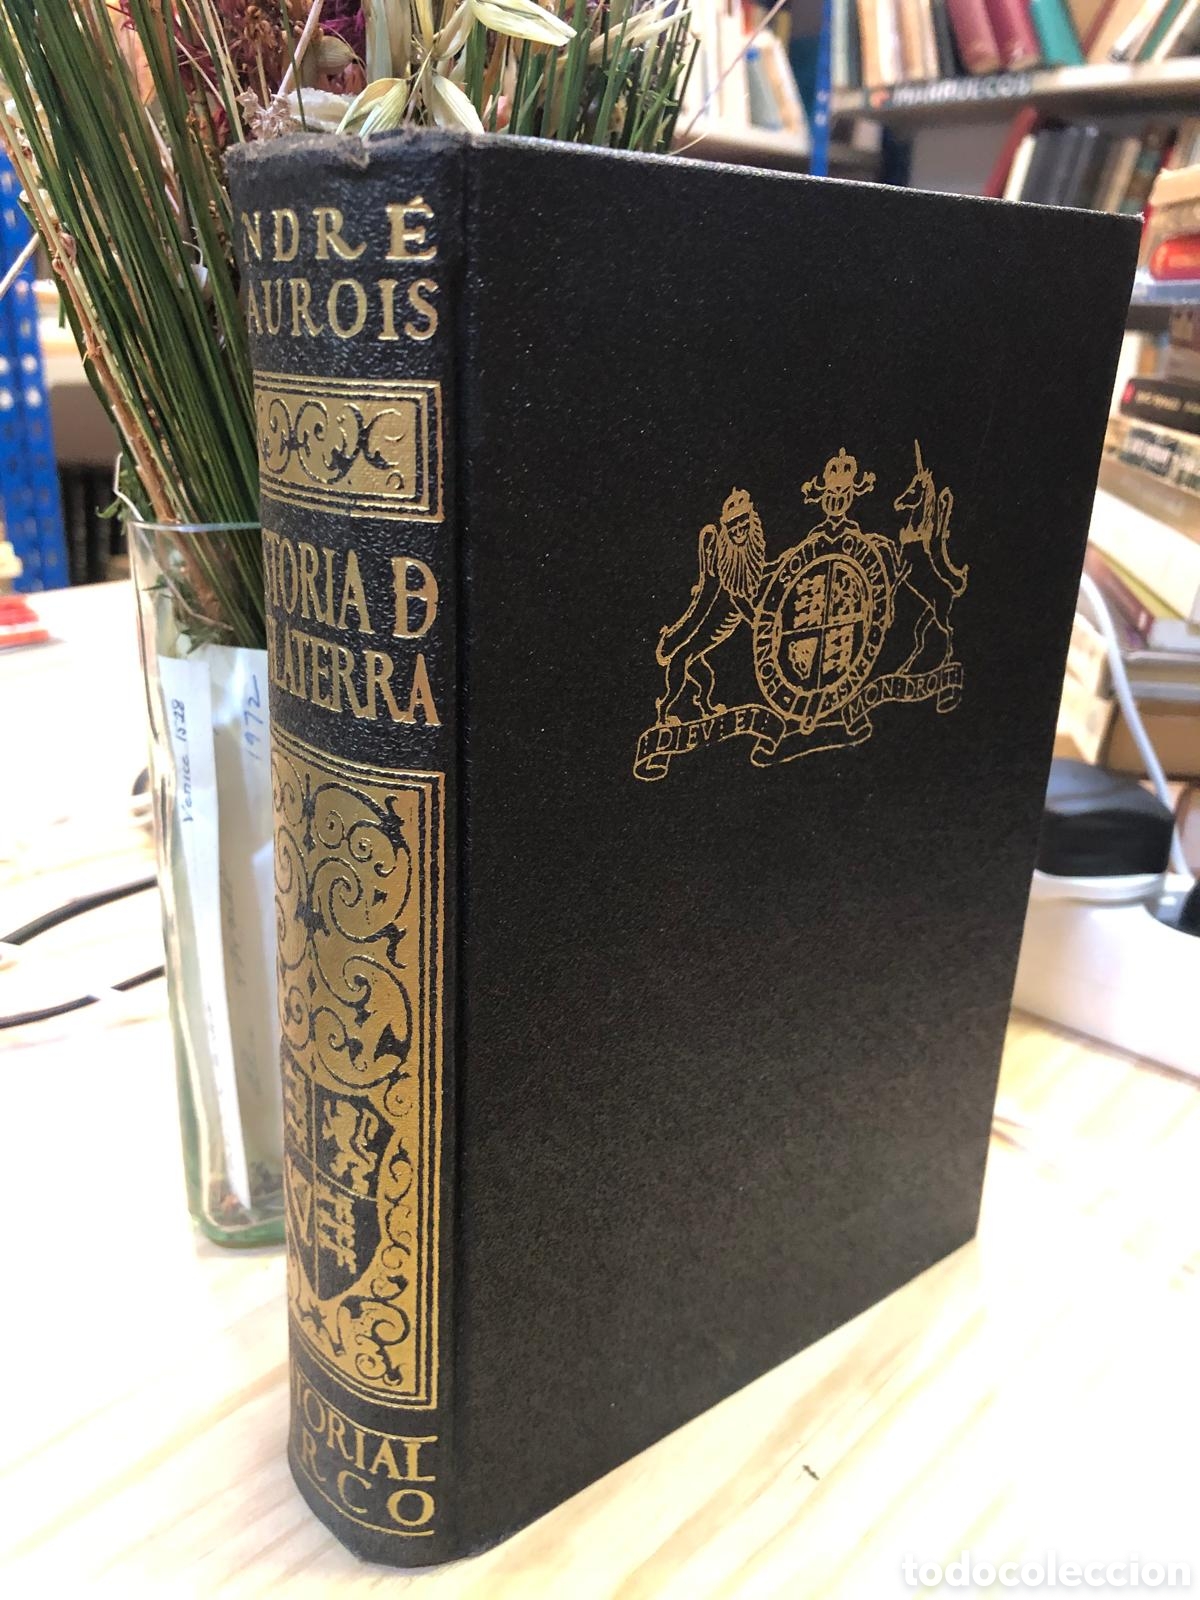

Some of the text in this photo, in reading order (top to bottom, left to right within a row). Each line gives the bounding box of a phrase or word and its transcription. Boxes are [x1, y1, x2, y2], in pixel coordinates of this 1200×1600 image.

[266, 614, 442, 727] LATERRA
[847, 677, 896, 724] MON
[242, 673, 264, 760] 1972
